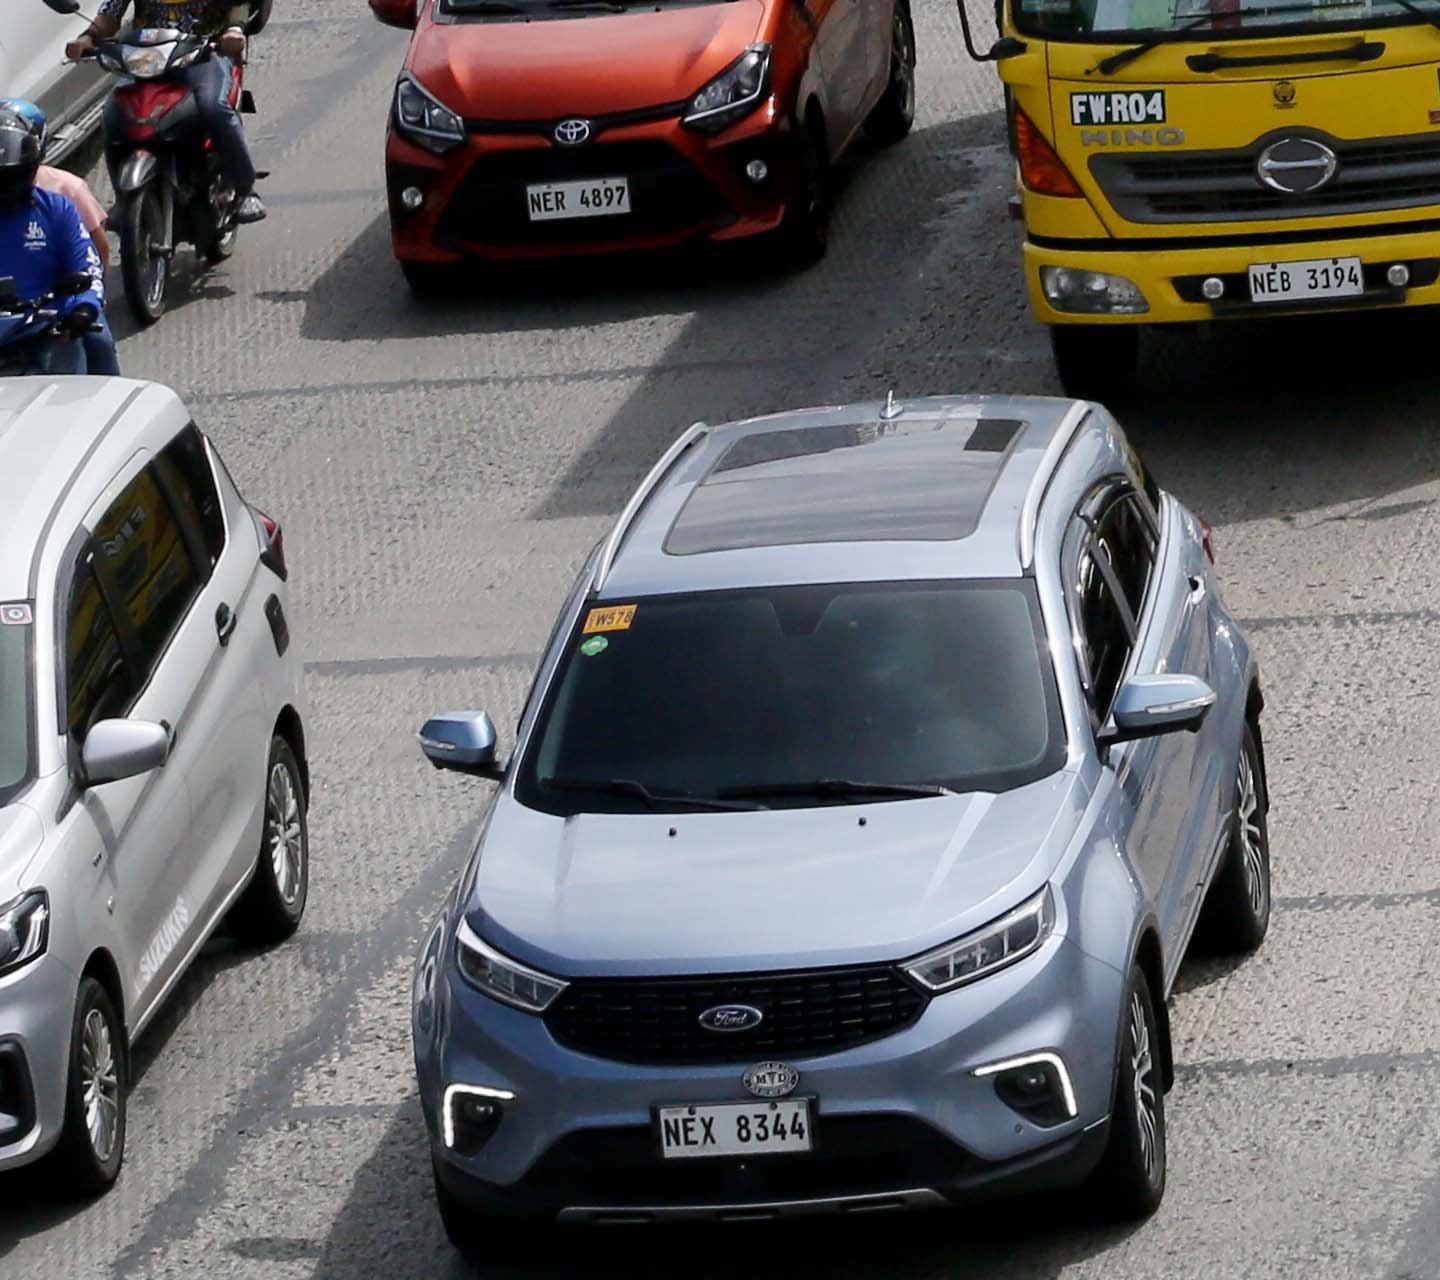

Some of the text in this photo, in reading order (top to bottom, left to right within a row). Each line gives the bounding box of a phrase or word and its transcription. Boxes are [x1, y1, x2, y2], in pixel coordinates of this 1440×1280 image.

[1081, 129, 1185, 146] HINO
[530, 185, 627, 214] NER 4897
[1253, 265, 1360, 294] NEB 3194
[714, 1010, 749, 1026] Ford
[663, 1110, 808, 1148] NEX 8344
